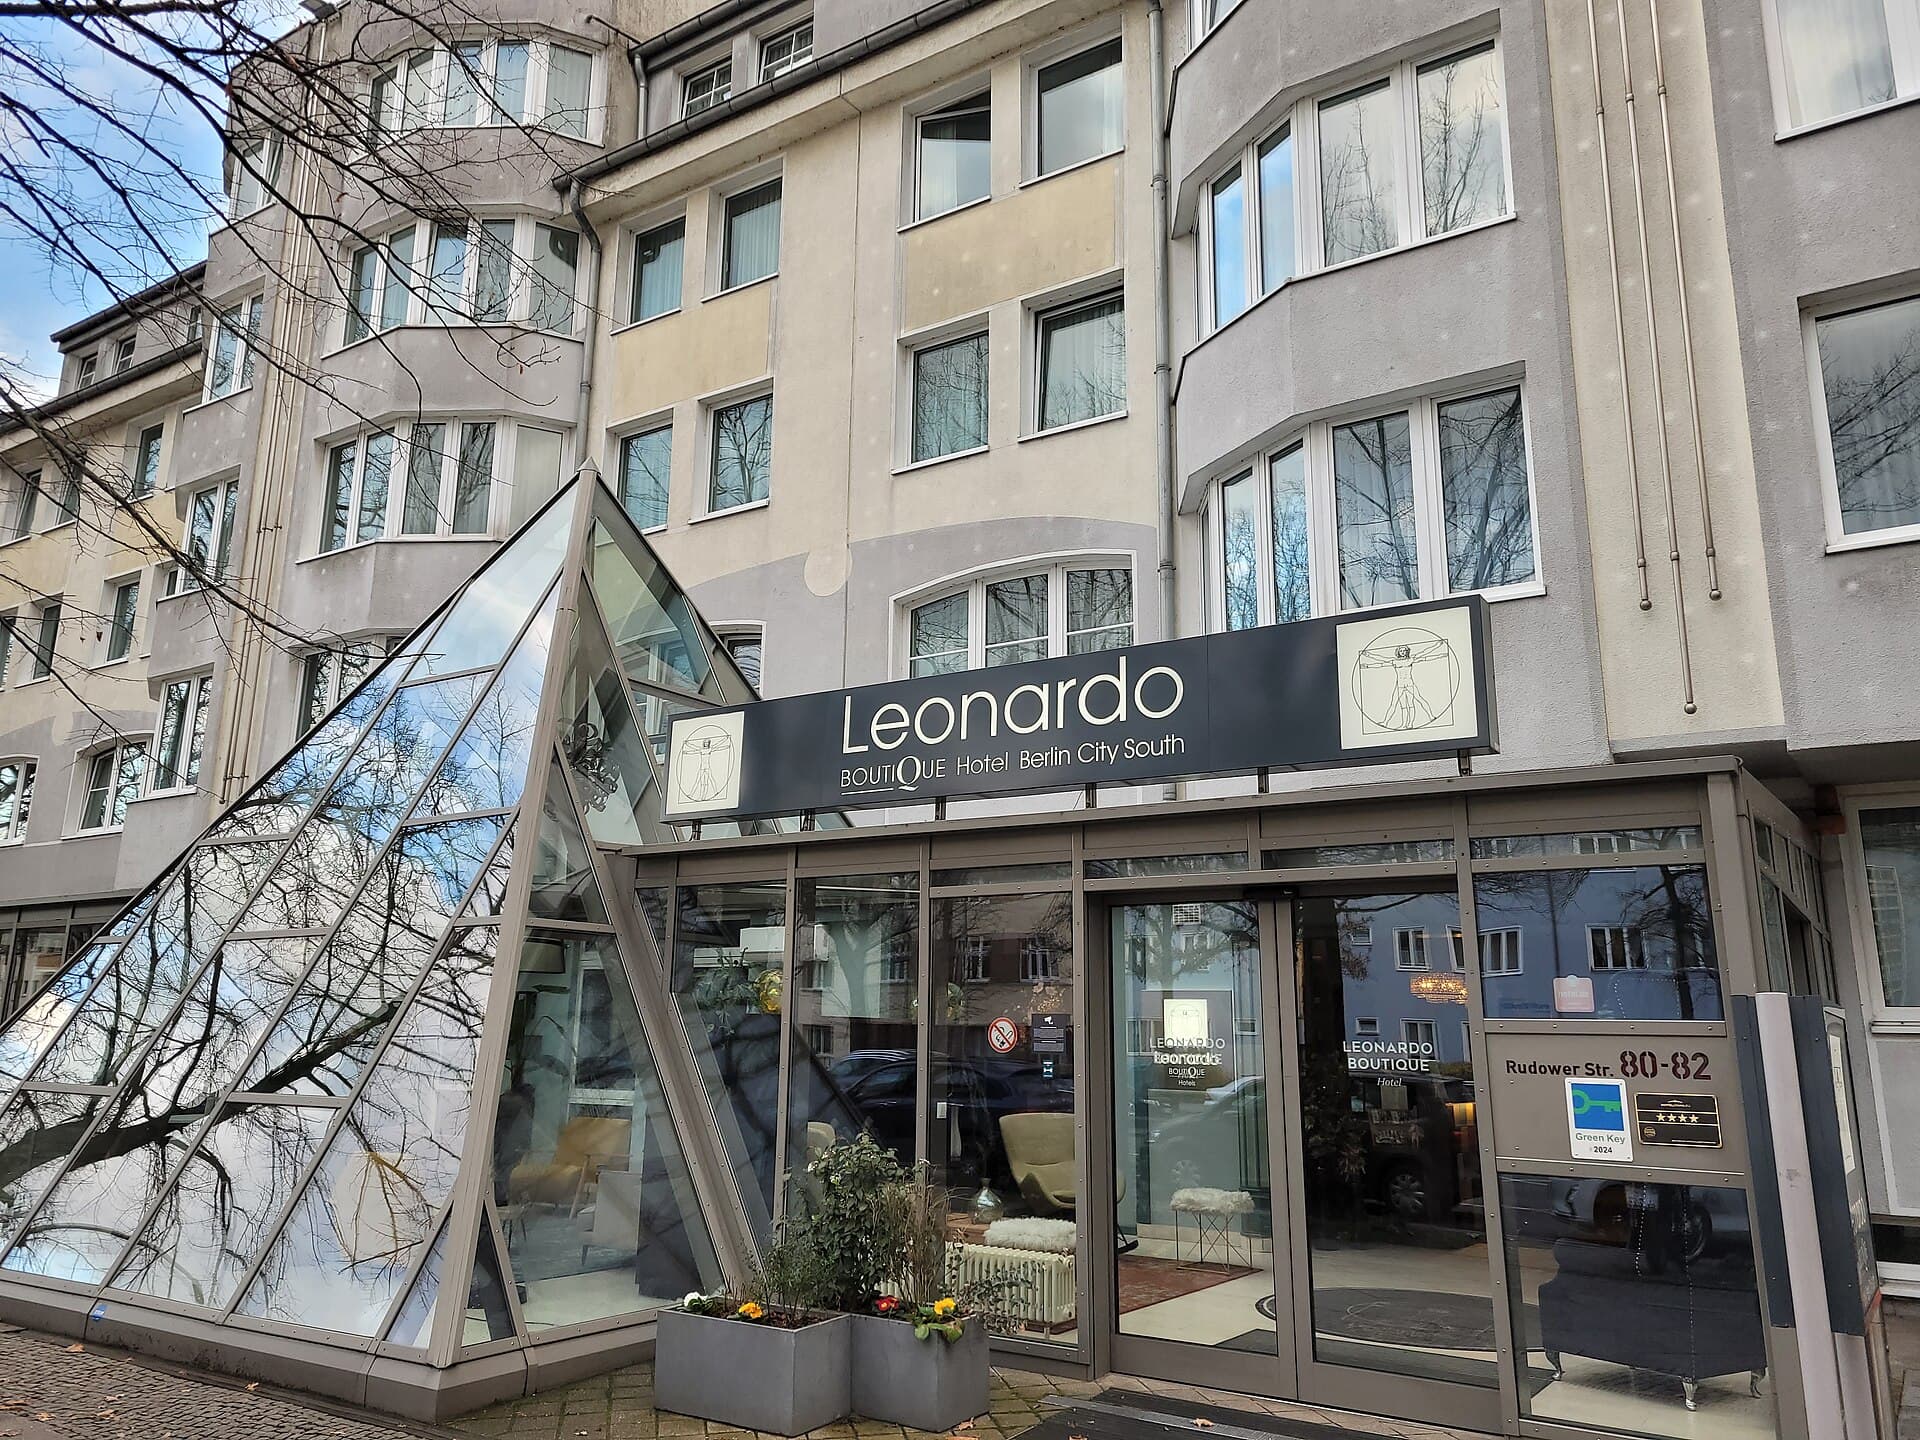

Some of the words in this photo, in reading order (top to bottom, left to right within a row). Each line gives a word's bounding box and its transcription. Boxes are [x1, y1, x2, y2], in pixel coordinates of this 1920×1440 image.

[843, 656, 1184, 754] Leonardo
[840, 755, 946, 792] BOUTIQUE
[956, 752, 1009, 776] Hotel
[1020, 747, 1071, 769] Berlin
[1077, 742, 1119, 765] City
[1124, 734, 1185, 759] South
[1149, 1037, 1226, 1049] LEONARDO
[1343, 1040, 1433, 1054] LEONARDO
[1347, 1057, 1430, 1071] BOUTIQUE
[1506, 1060, 1580, 1076] Rudower
[1584, 1062, 1614, 1077] Str.
[1620, 1050, 1712, 1080] 80-82
[1376, 1077, 1402, 1087] Hotel
[1575, 1132, 1604, 1142] Green
[1606, 1134, 1626, 1145] Key
